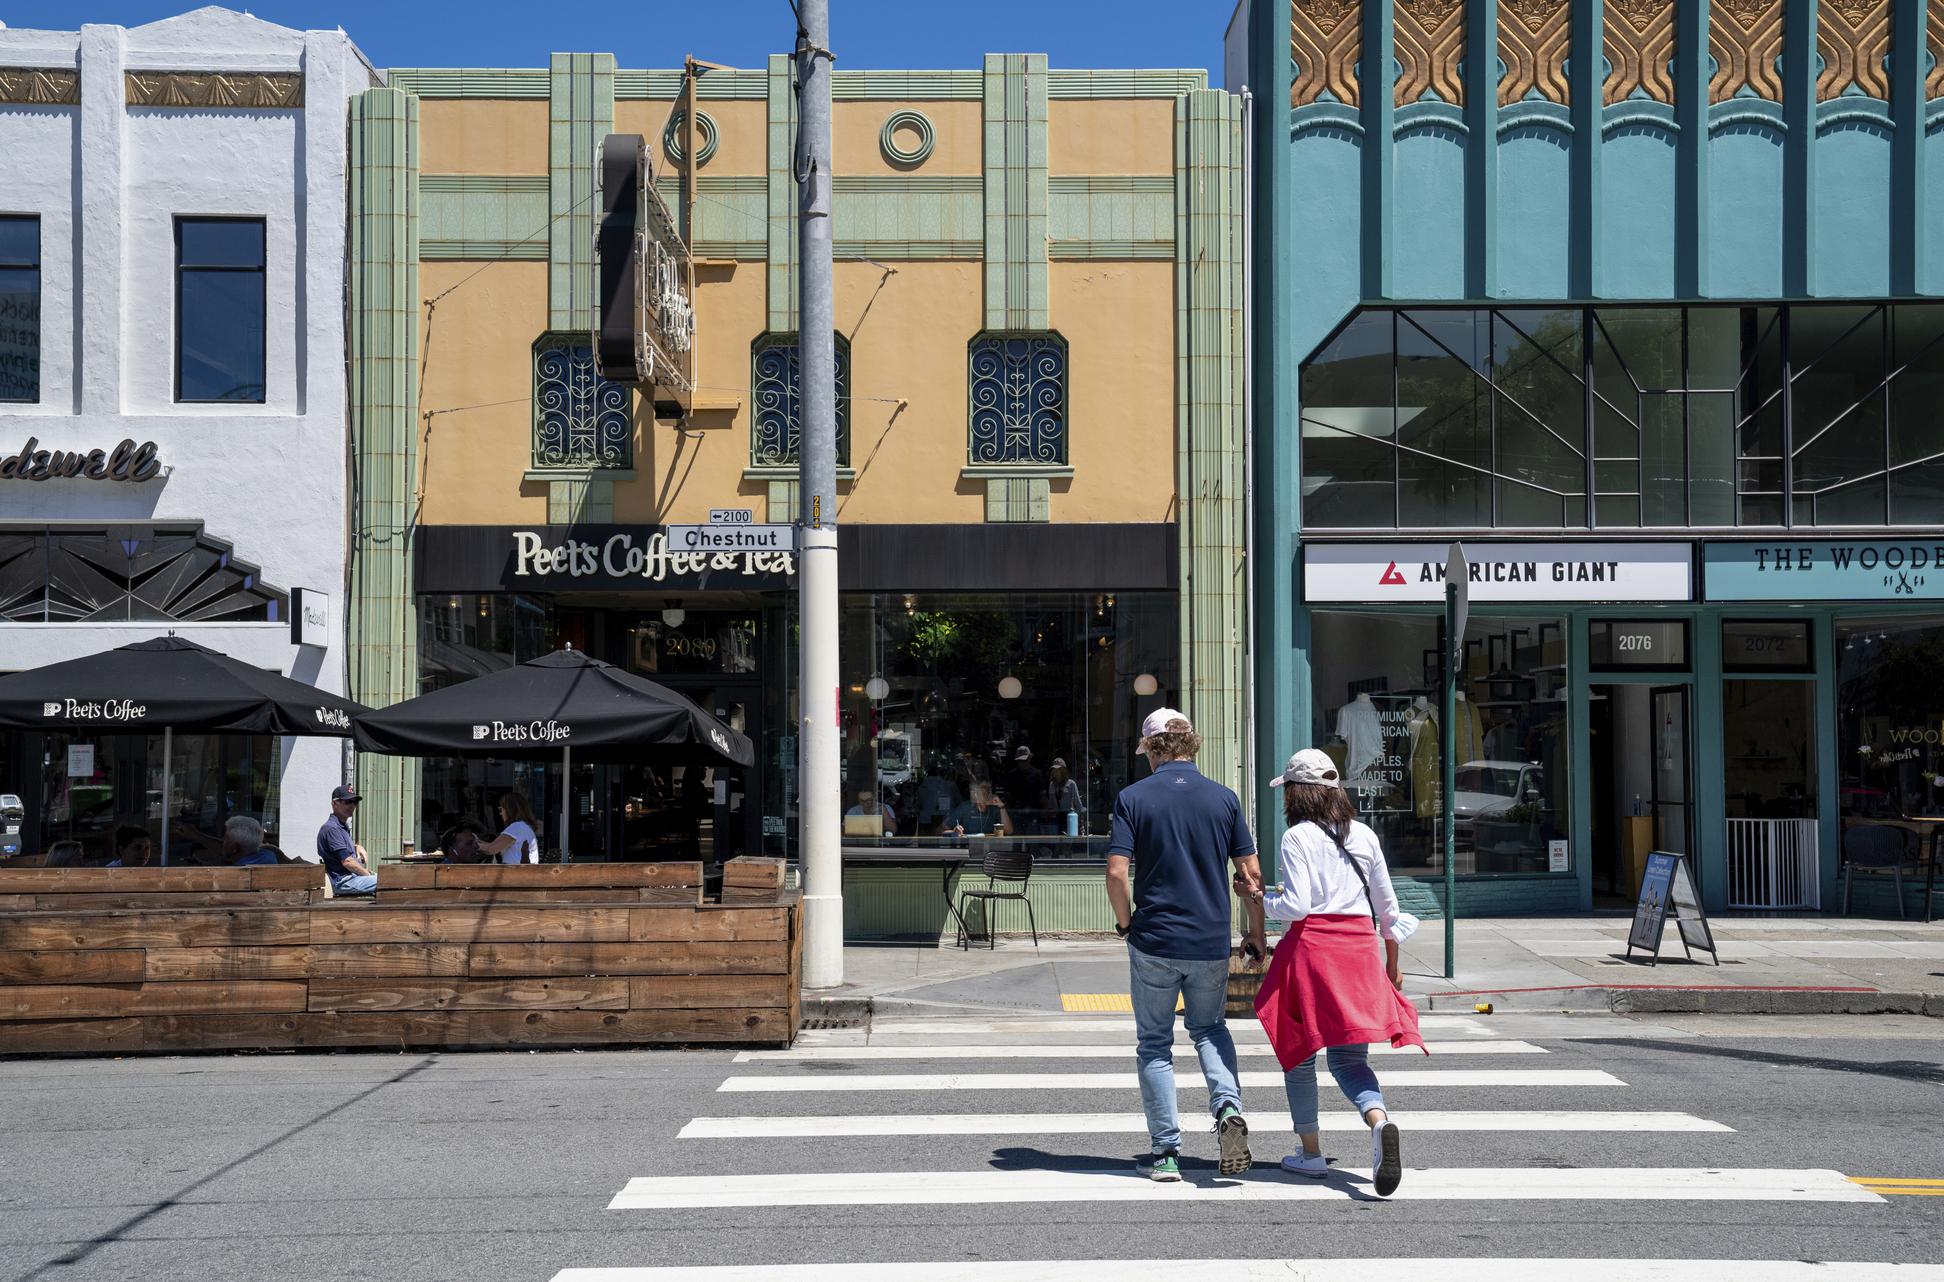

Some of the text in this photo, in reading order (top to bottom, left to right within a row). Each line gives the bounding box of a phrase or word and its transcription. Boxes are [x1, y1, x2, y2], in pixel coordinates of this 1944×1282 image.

[0, 436, 161, 482] dewell
[722, 511, 750, 523] 2100
[684, 530, 777, 547] Chestnut
[513, 531, 599, 577] Peet's
[602, 532, 706, 582] Coffee
[1755, 548, 1813, 571] THE
[1419, 562, 1618, 582] AMRICAN GIANT
[1618, 635, 1652, 651] 2076
[1745, 638, 1784, 651] 2072
[64, 698, 146, 720] Peet's Coffee
[492, 720, 570, 742] Peet's Coffee
[1358, 770, 1403, 781] MADE TO
[1358, 785, 1385, 797] LAST.
